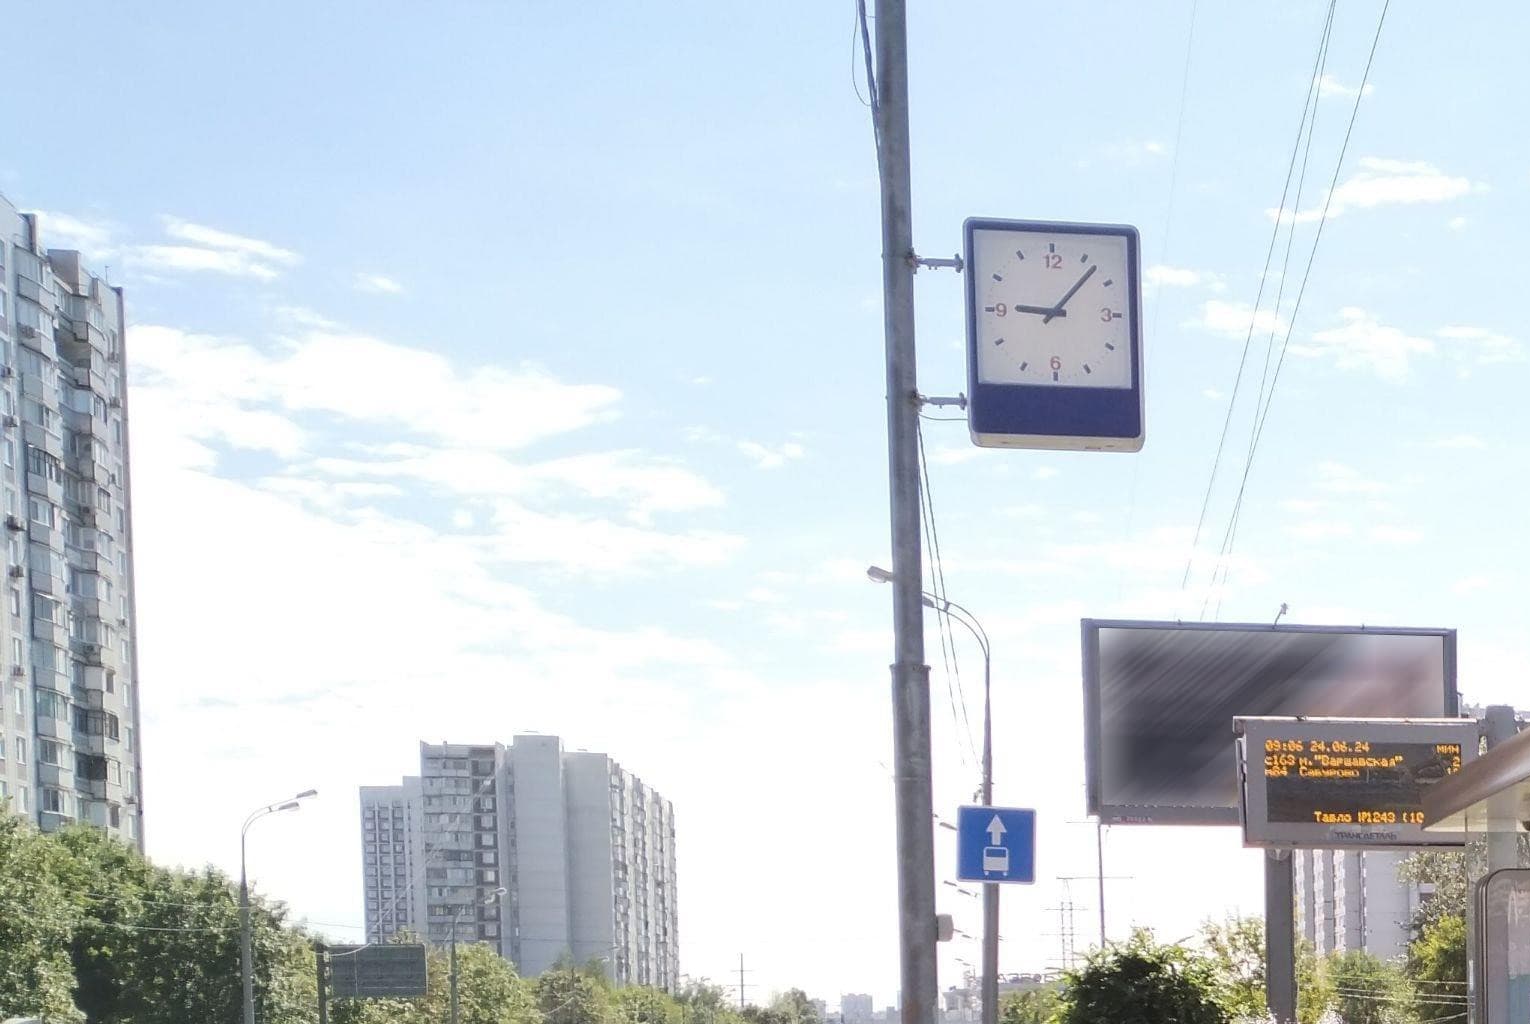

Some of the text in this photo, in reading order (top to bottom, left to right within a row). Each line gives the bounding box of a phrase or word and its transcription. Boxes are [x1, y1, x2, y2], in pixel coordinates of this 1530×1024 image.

[1044, 254, 1063, 269] 12
[995, 303, 1008, 318] 9
[1101, 308, 1112, 322] 3
[1050, 356, 1061, 370] 6
